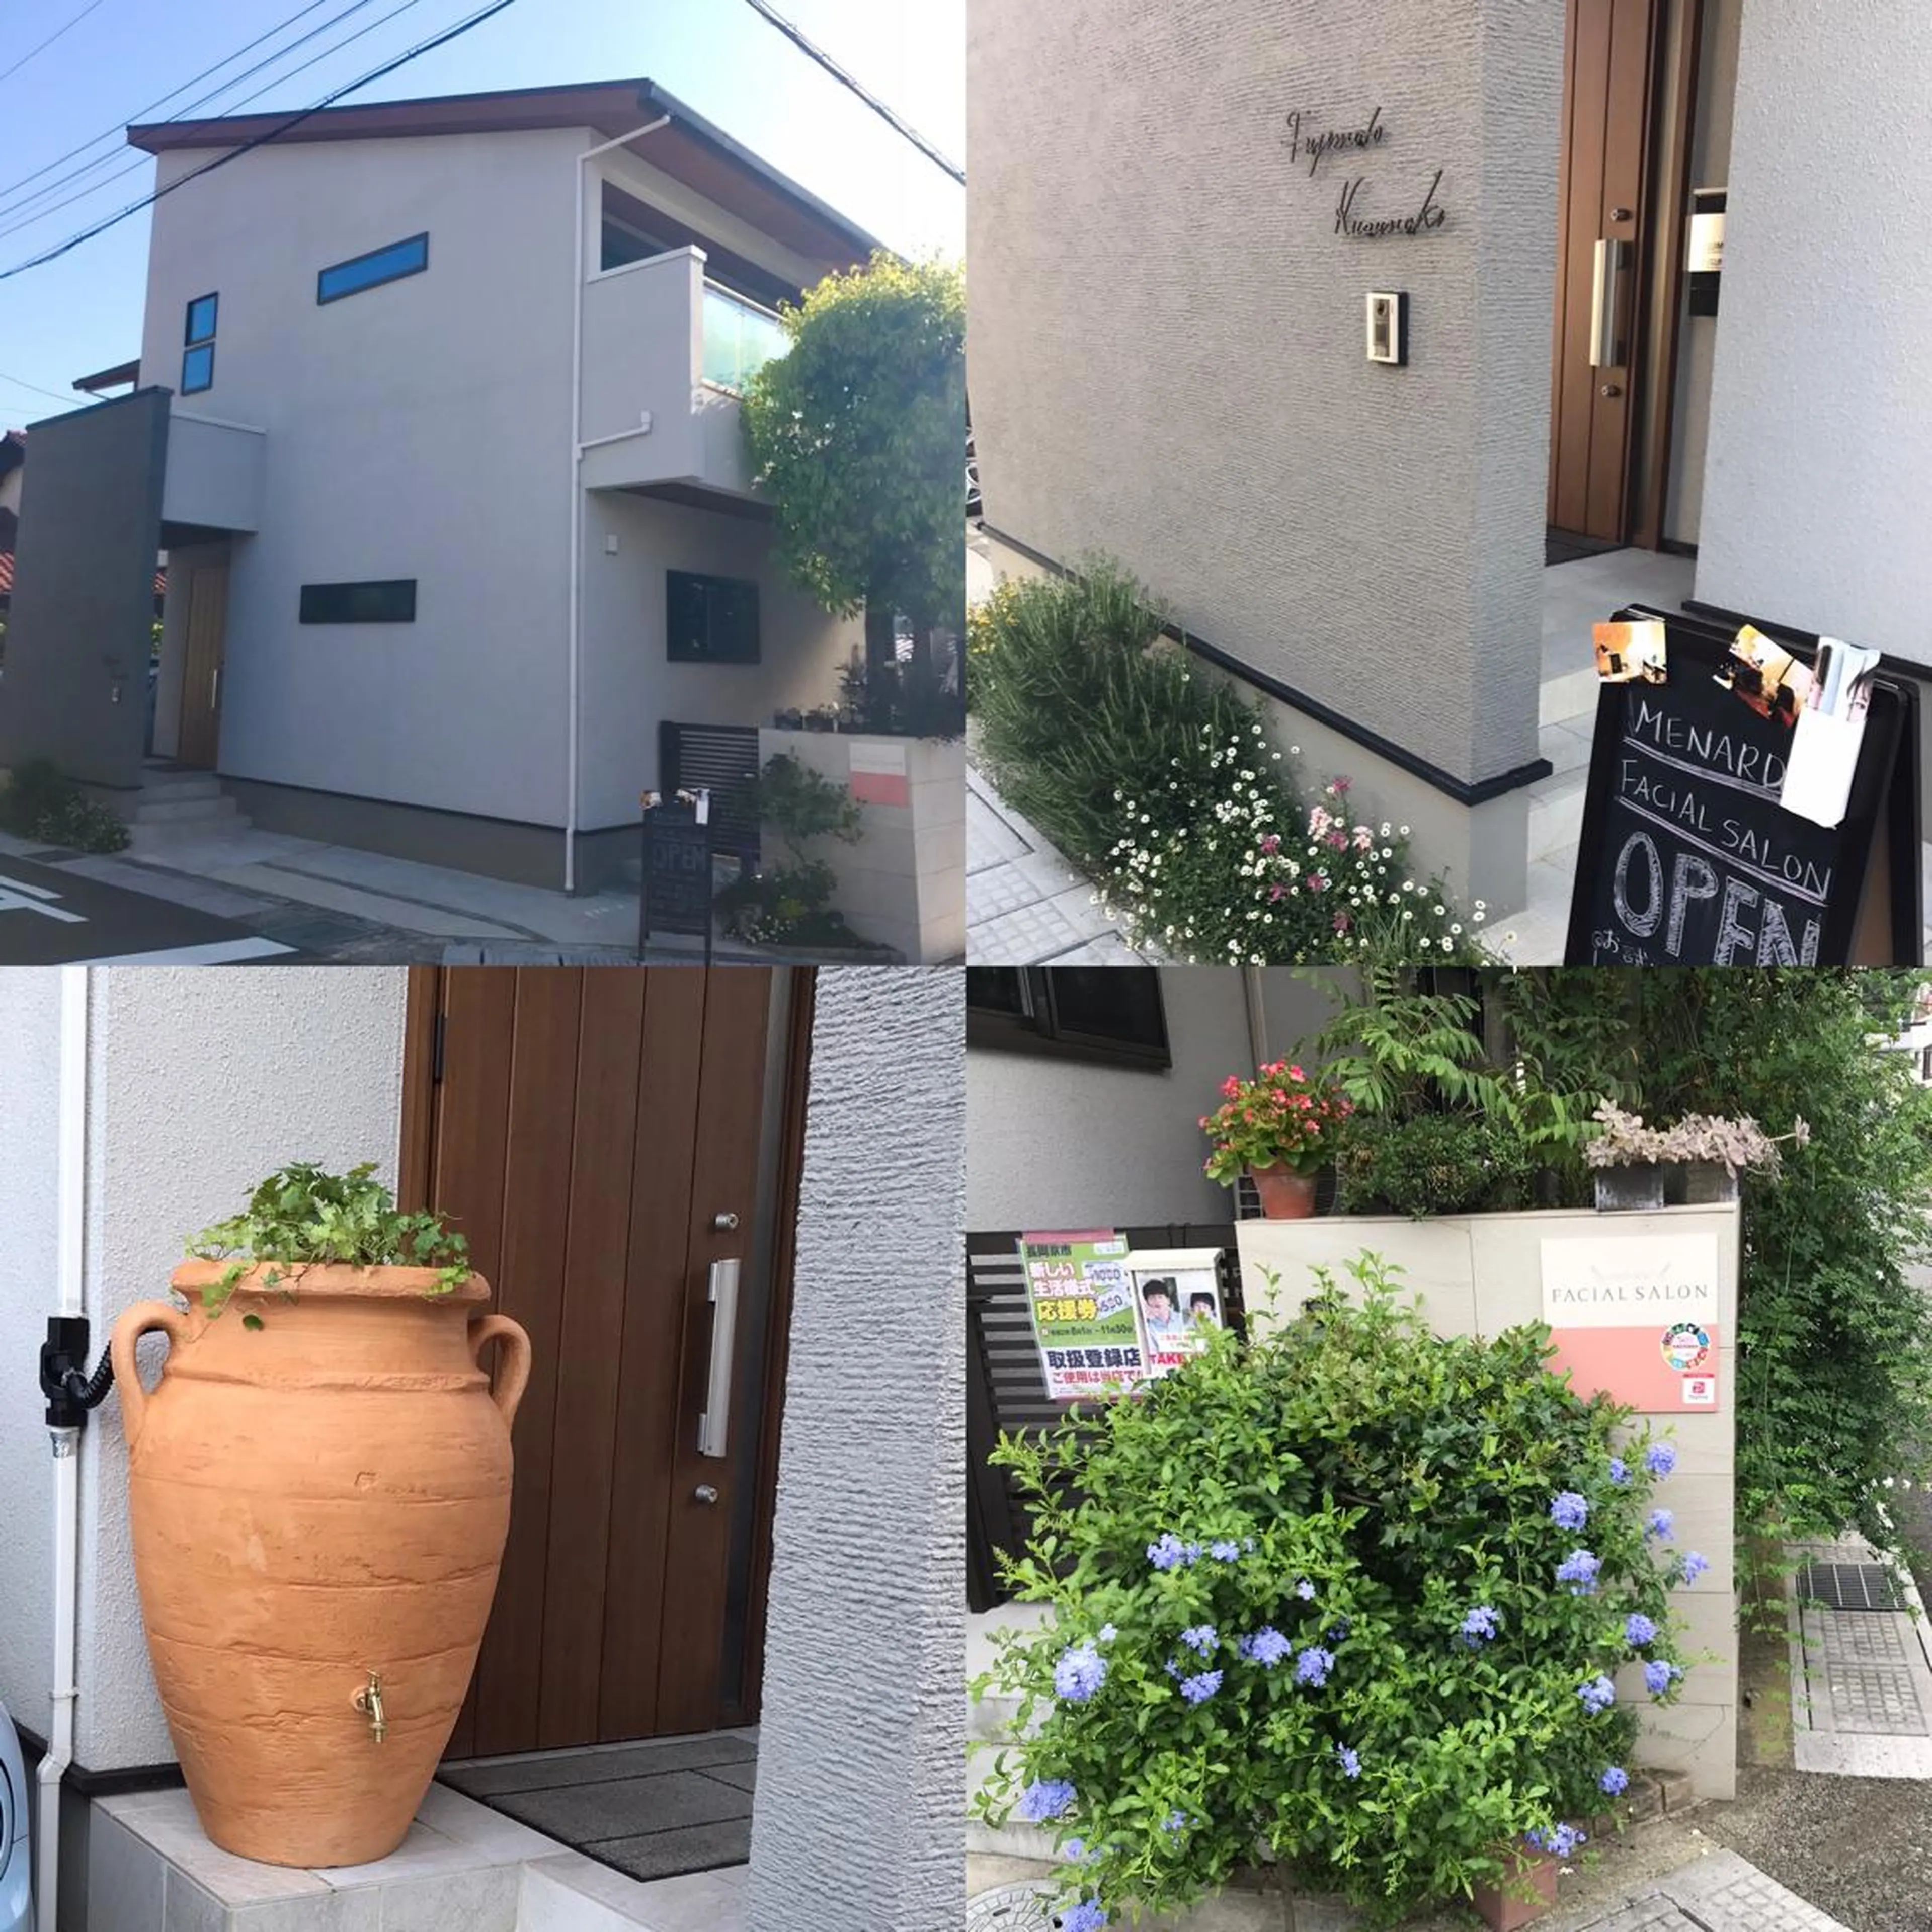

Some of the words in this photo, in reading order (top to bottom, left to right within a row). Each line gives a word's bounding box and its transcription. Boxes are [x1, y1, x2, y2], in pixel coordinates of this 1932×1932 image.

[1634, 700, 1785, 790] MENARD
[1621, 759, 1712, 832] FACIAL
[1721, 819, 1832, 901] SALON
[1613, 831, 1822, 965] OPEN
[1552, 1287, 1627, 1303] FACIAL
[1635, 1284, 1708, 1301] SALON
[1046, 1347, 1142, 1369] 取扱登録店
